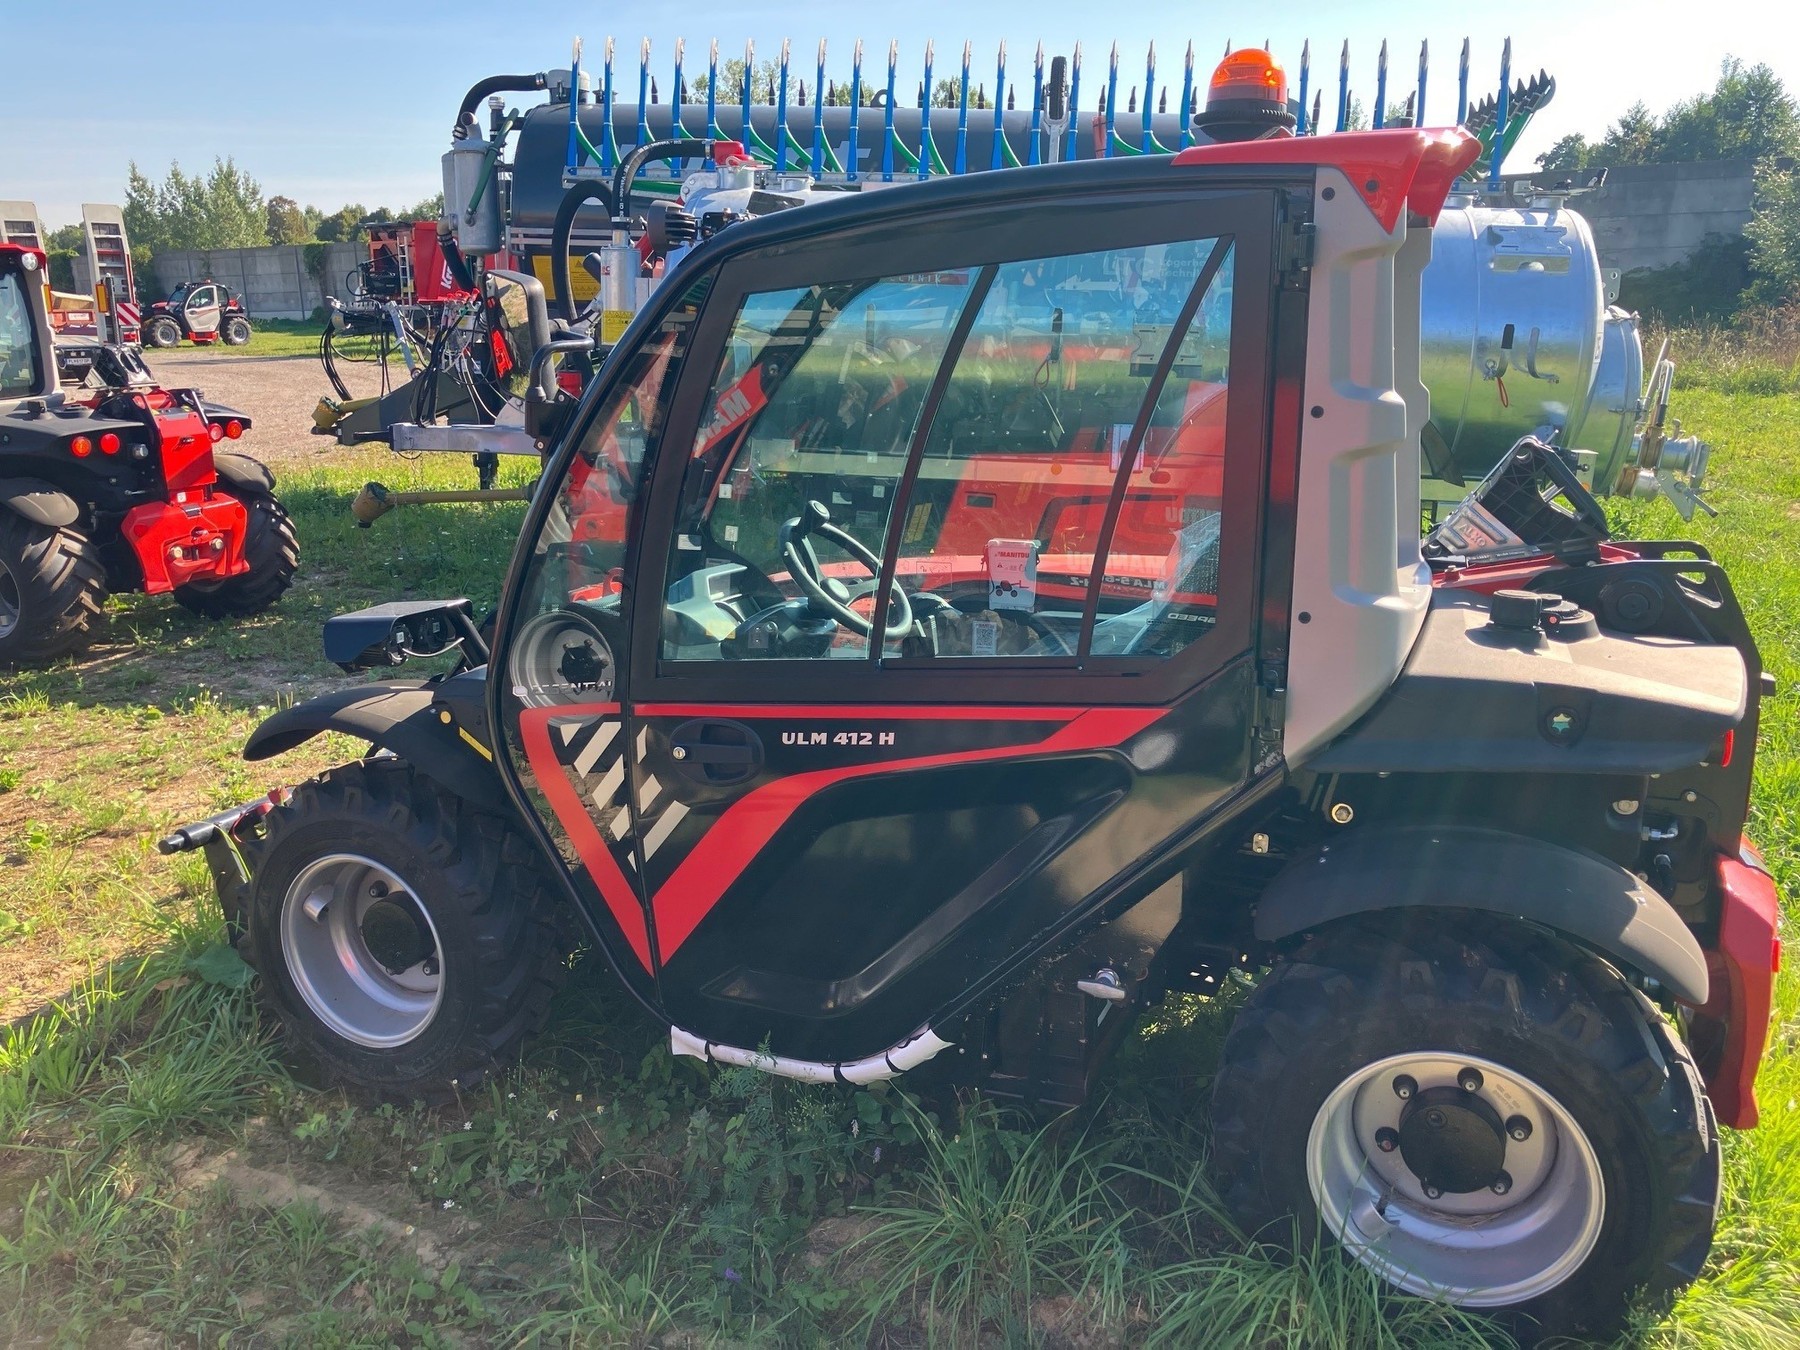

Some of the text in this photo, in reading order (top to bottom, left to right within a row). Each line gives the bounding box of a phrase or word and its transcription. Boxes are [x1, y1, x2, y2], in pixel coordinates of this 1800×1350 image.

[1001, 550, 1030, 559] MANITOU
[782, 732, 895, 745] ULM 412 H
